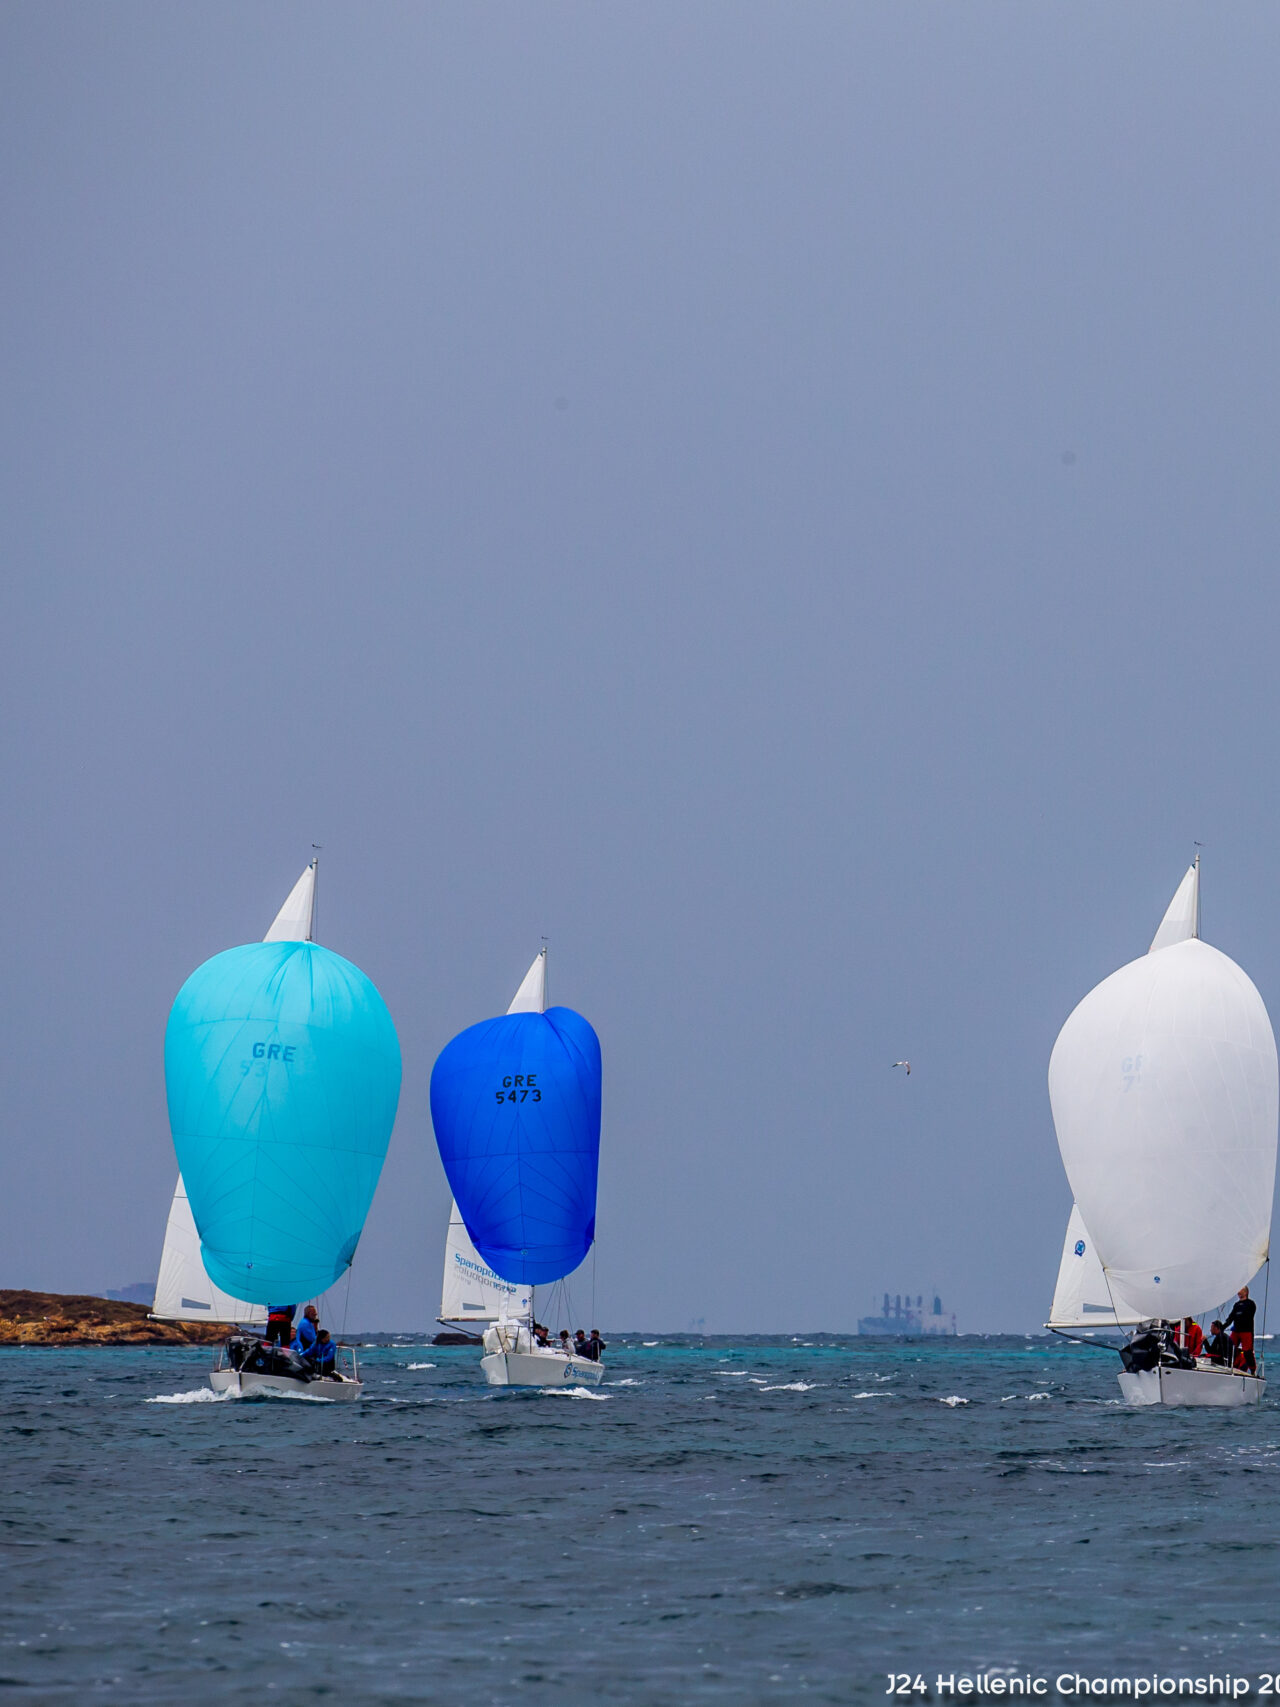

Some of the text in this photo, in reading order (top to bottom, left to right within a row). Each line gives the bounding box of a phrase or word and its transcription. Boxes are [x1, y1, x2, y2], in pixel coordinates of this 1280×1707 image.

[252, 1042, 297, 1063] GRE
[502, 1074, 537, 1088] GRE
[495, 1089, 542, 1104] 5473
